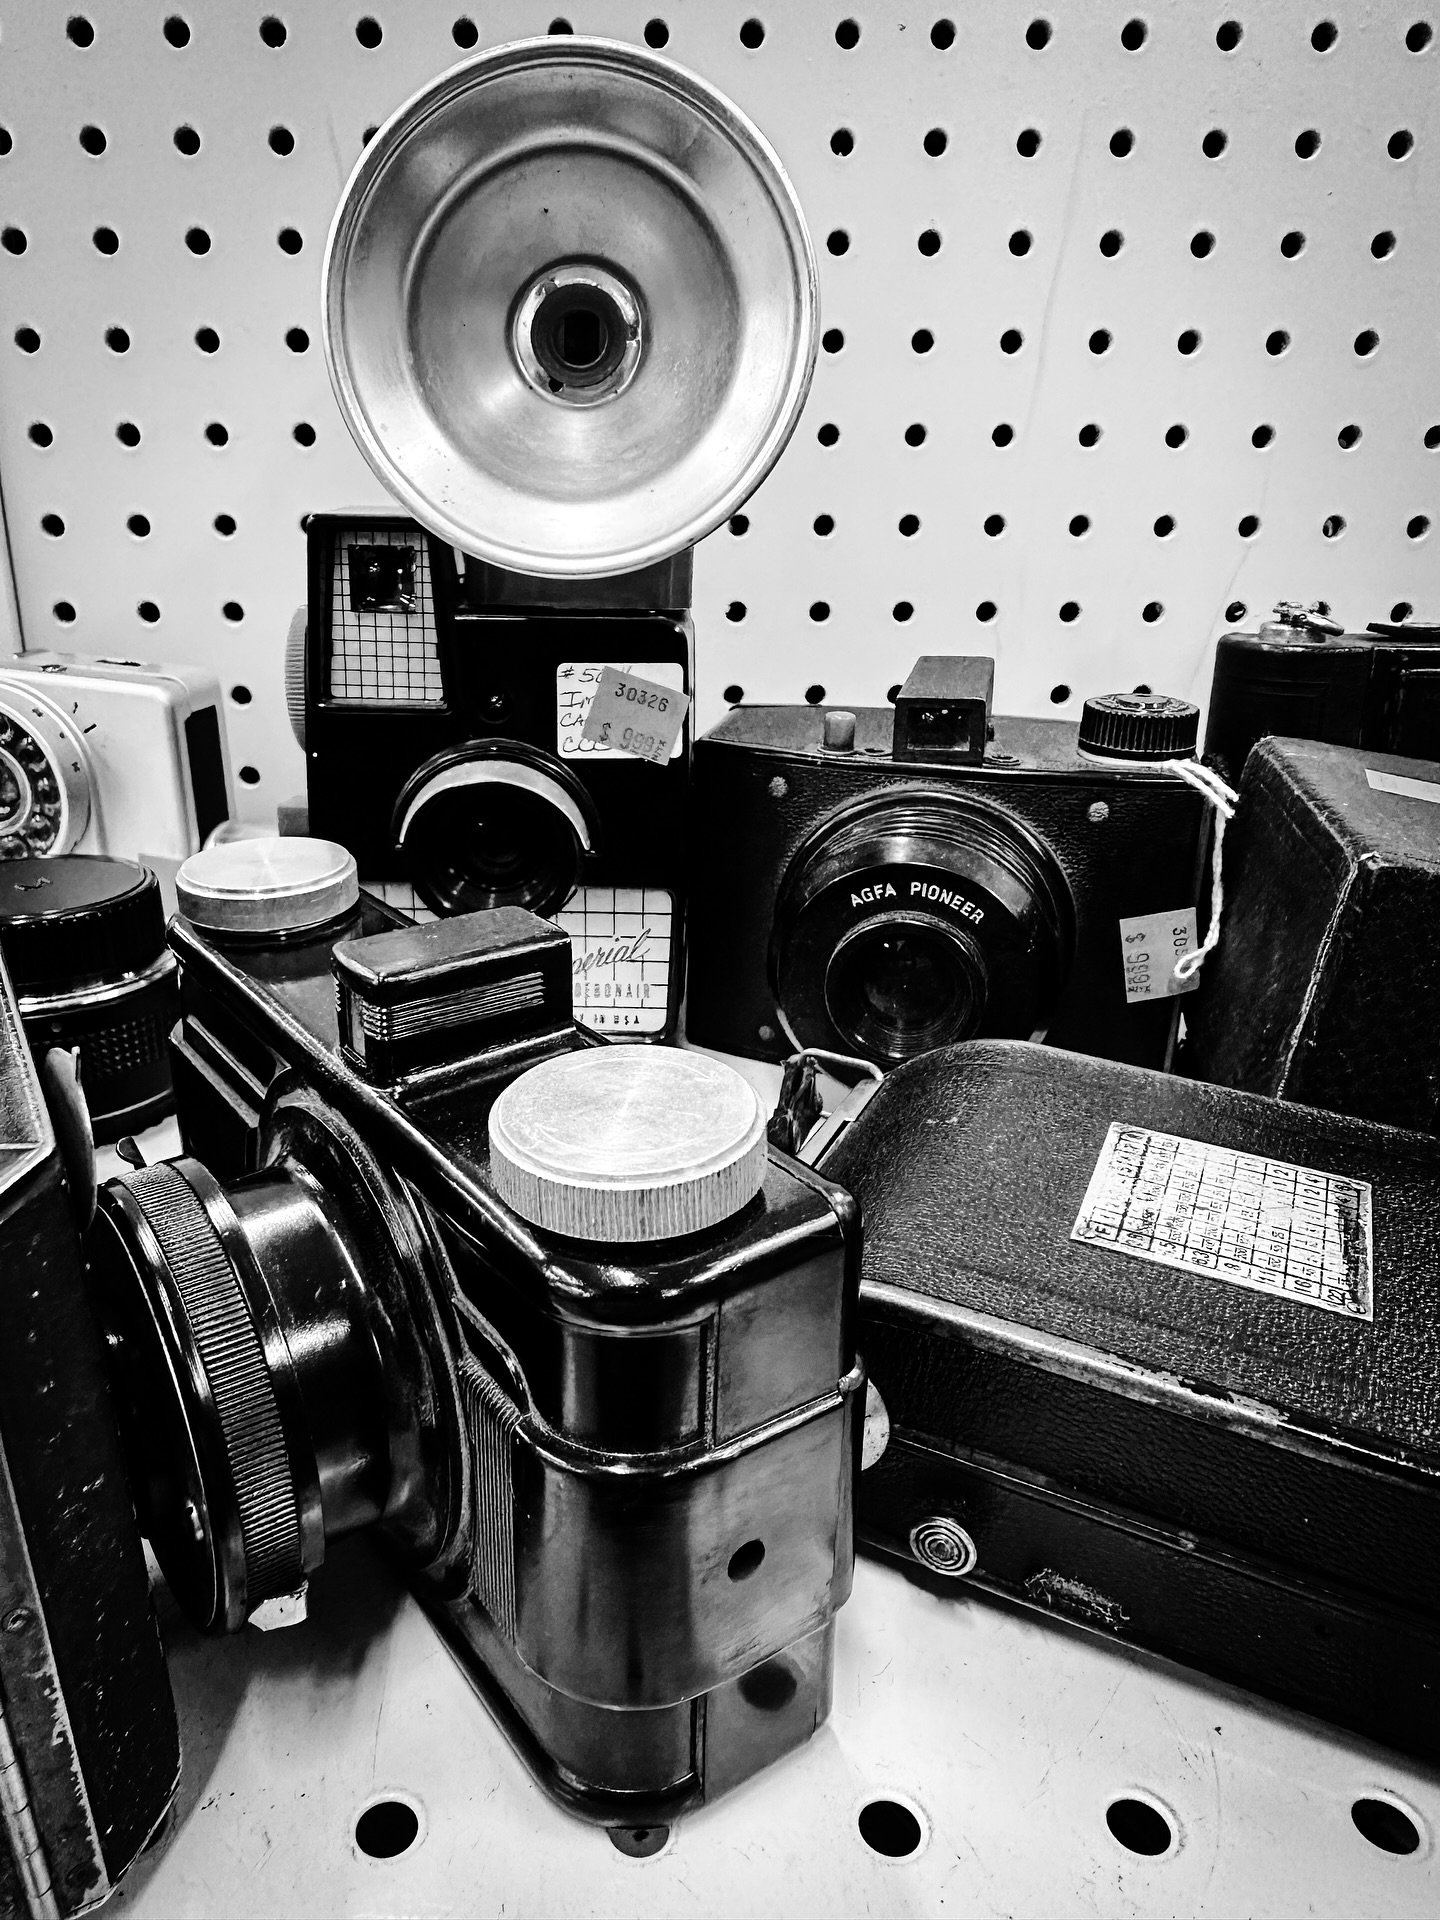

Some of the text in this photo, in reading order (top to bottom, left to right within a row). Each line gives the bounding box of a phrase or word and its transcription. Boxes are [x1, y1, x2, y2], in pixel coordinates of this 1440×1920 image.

[615, 682, 669, 712] 30326
[850, 881, 985, 925] AGFA PIONEER
